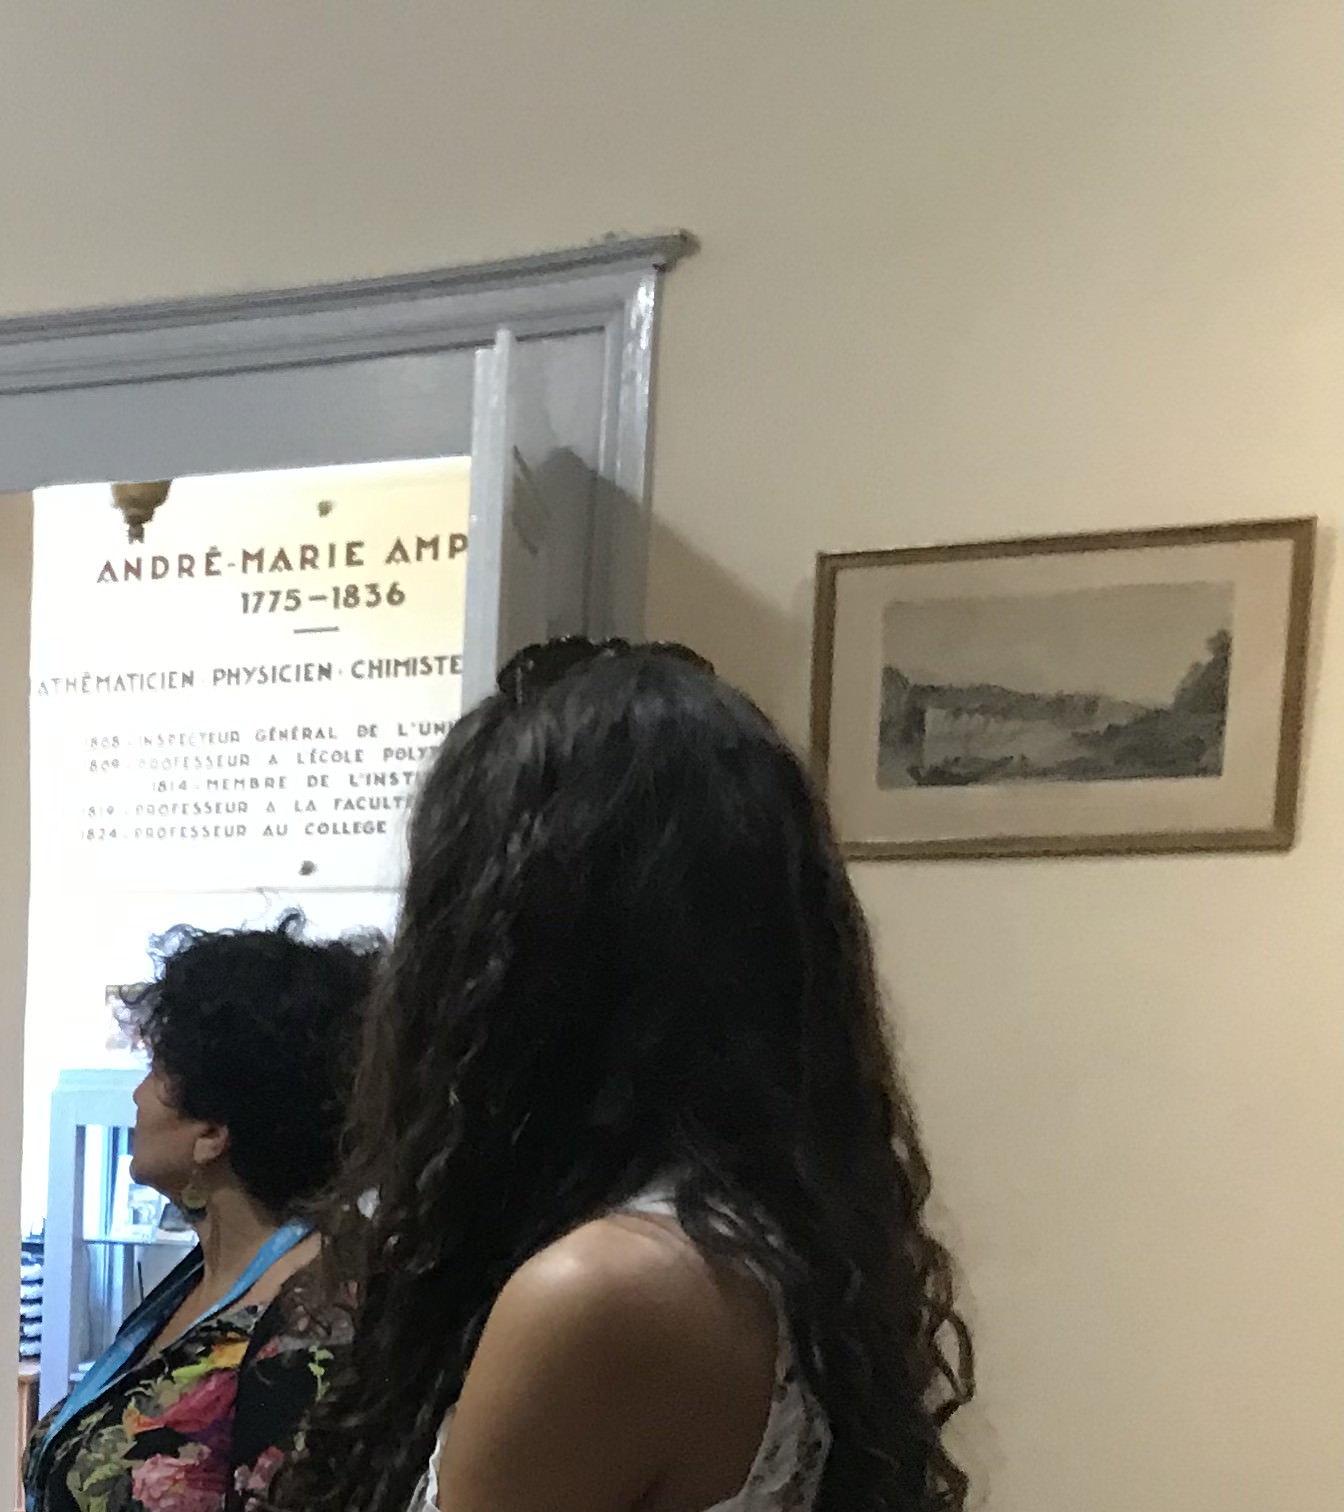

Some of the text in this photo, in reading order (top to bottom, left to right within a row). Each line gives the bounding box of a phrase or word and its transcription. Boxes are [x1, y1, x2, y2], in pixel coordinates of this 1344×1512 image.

[96, 539, 366, 584] ANDRÉ-MARIE
[213, 662, 333, 687] PHYSICIEN
[351, 654, 464, 680] CHIMISTE
[255, 725, 338, 743] GÉNÉRAL
[357, 724, 378, 738] DE
[297, 746, 365, 765] LÉCOLE
[207, 775, 288, 791] MEMBRE
[307, 773, 330, 789] DE
[295, 799, 318, 813] LA
[263, 823, 289, 837] AU
